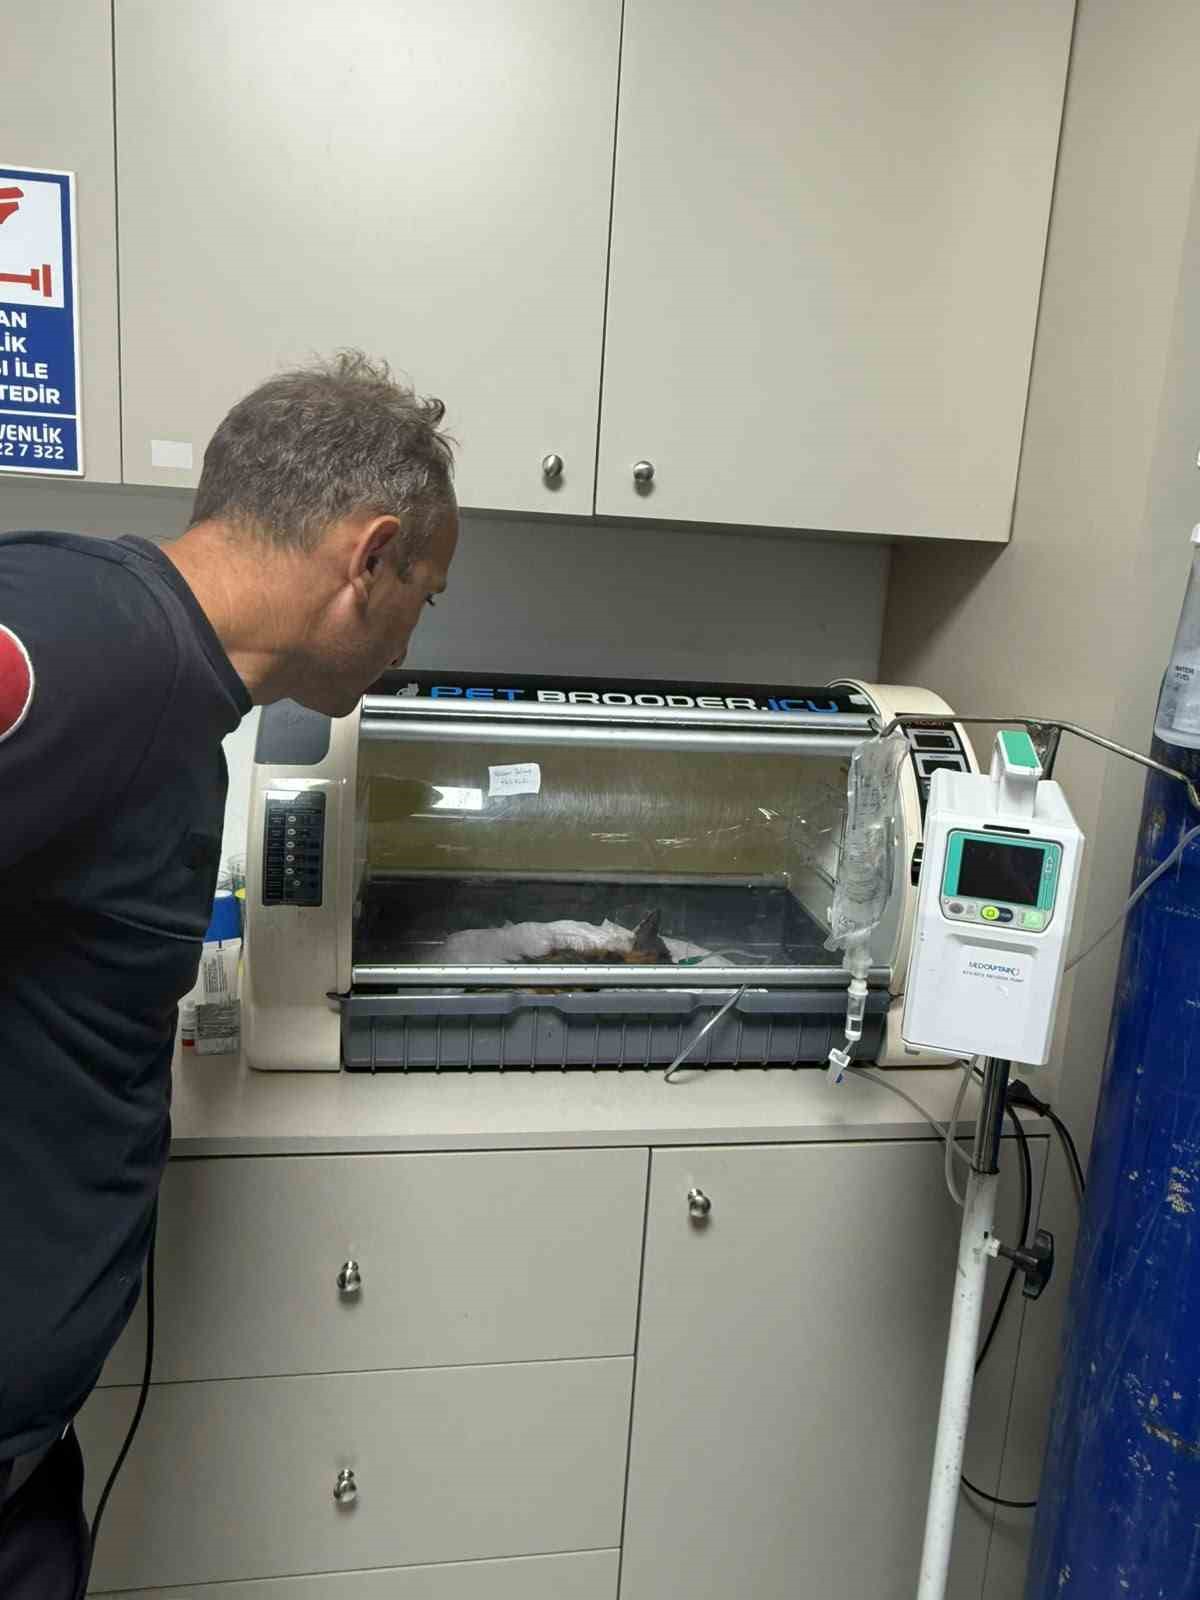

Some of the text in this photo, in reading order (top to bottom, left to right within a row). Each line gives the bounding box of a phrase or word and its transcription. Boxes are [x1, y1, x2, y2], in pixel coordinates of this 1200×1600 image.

[15, 356, 49, 379] İLE
[18, 443, 28, 457] 7
[33, 444, 64, 460] 322
[431, 686, 525, 701] PET
